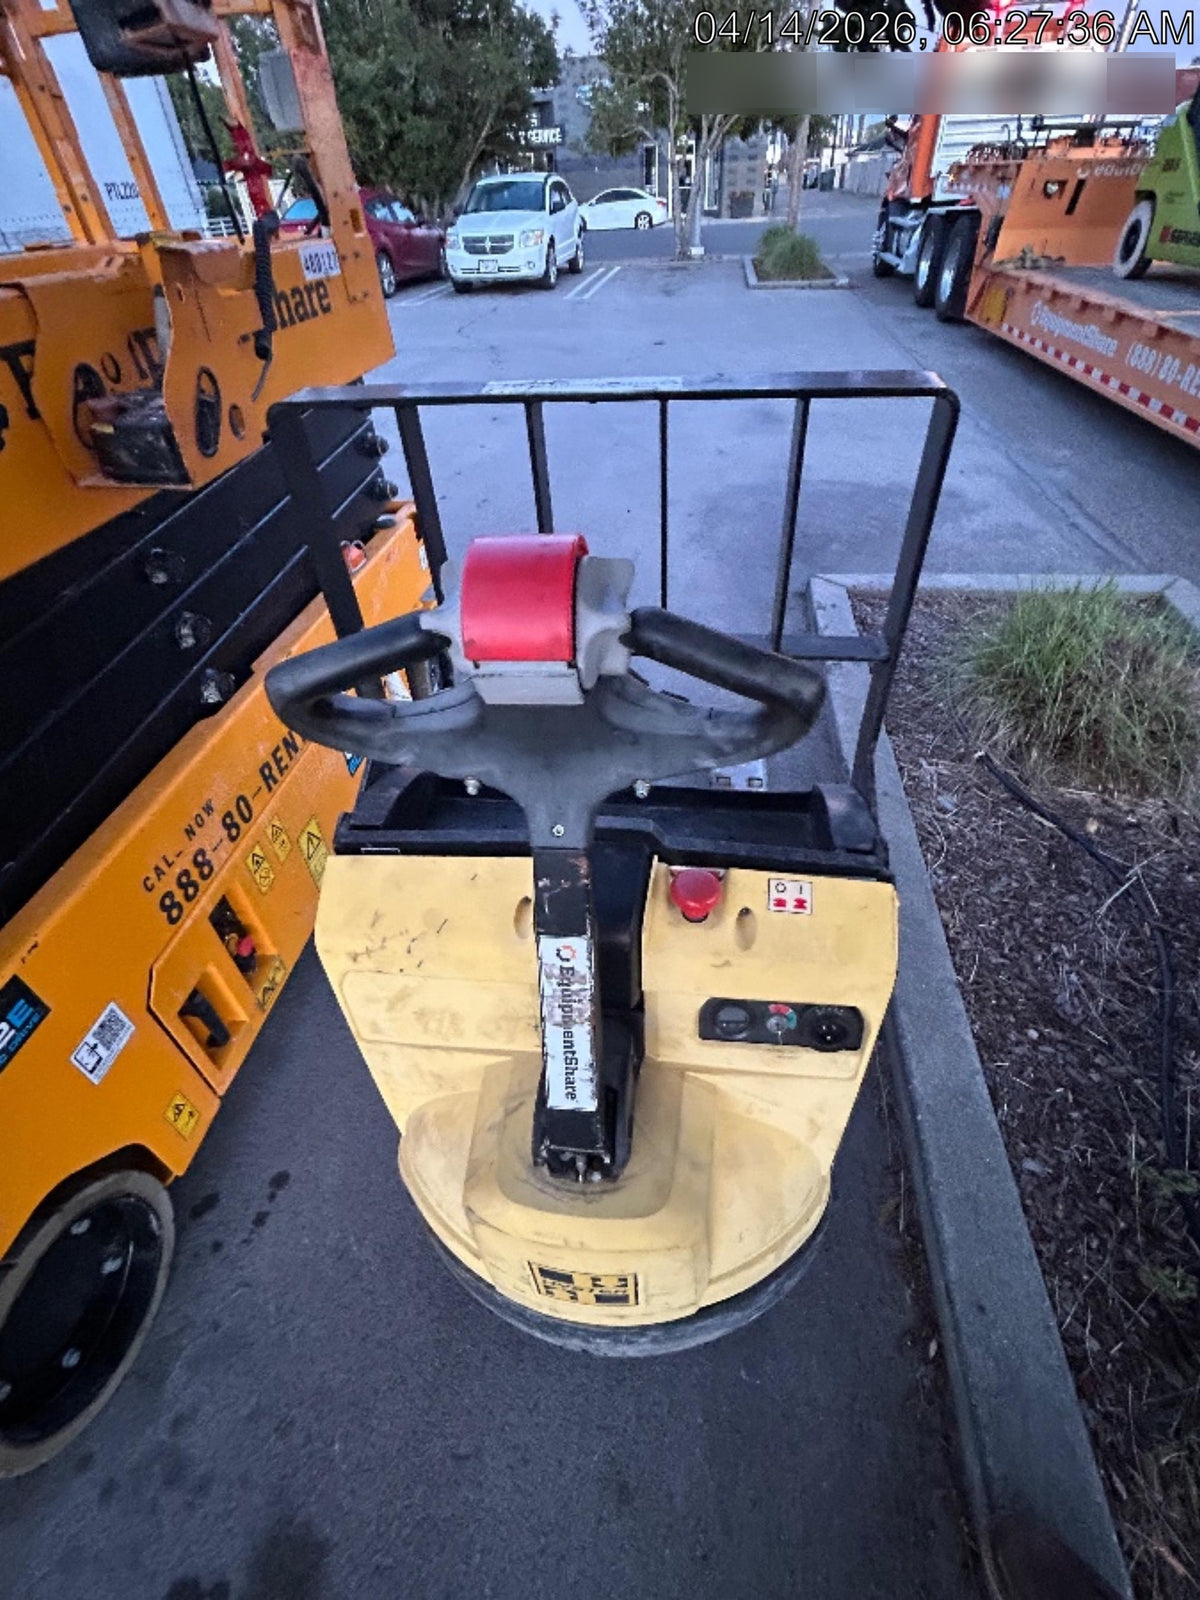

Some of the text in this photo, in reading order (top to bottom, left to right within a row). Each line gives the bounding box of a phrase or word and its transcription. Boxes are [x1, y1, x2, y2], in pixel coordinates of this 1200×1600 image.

[272, 279, 332, 331] hare
[143, 797, 215, 892] CAL NOW
[159, 730, 305, 925] 888-80-REN
